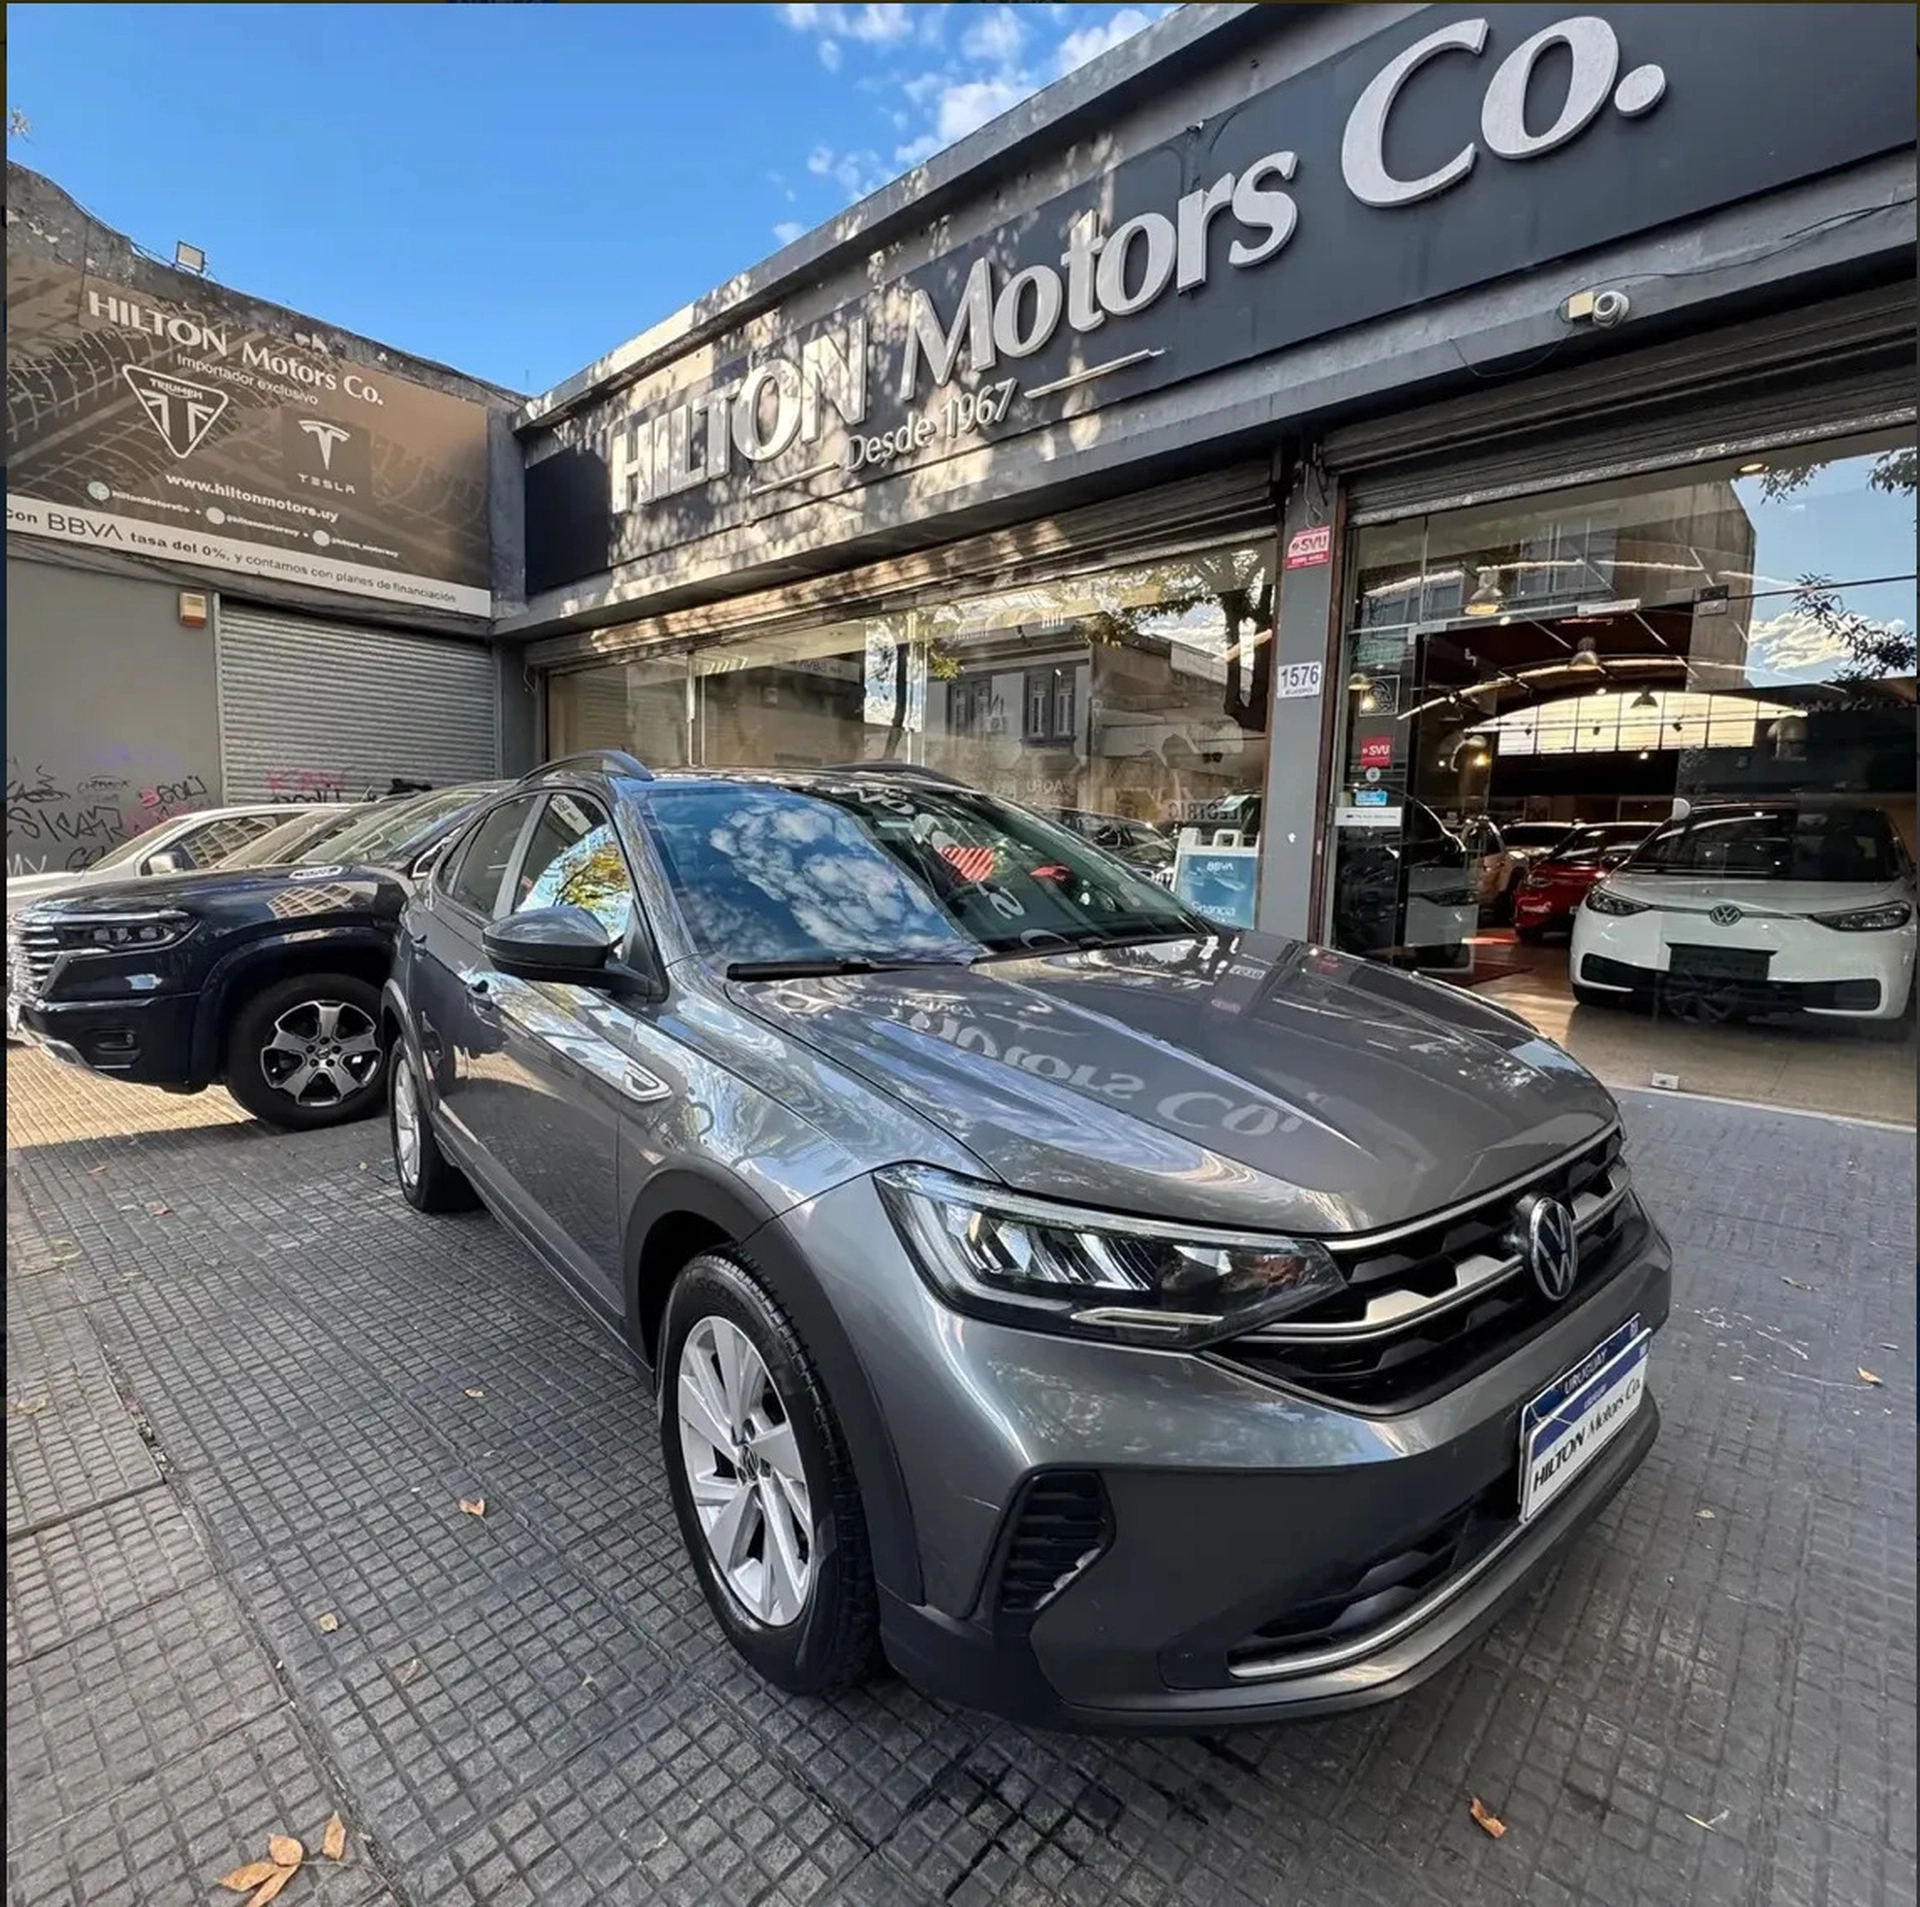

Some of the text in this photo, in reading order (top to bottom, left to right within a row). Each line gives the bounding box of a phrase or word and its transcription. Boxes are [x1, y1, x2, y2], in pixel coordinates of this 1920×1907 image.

[612, 16, 1667, 514] HILTON Motors Co.
[89, 290, 383, 405] HILTON Motors Co.
[149, 378, 203, 400] TRIUMPH
[177, 353, 318, 405] Importador exclusivo
[844, 377, 1019, 473] Desde 1967
[165, 474, 338, 523] www.hiltonmotors.uy
[297, 473, 356, 494] TESLA
[48, 513, 123, 541] BBVA
[130, 532, 167, 548] tasa
[172, 541, 197, 554] del
[234, 553, 242, 564] y
[246, 554, 308, 576] contamos
[310, 568, 334, 579] con
[336, 573, 374, 588] planes
[376, 579, 391, 591] de
[1281, 664, 1319, 688] 1576
[1564, 1348, 1607, 1395] URUGUAY
[1533, 1427, 1586, 1492] HILTON
[1587, 1396, 1624, 1439] Motors
